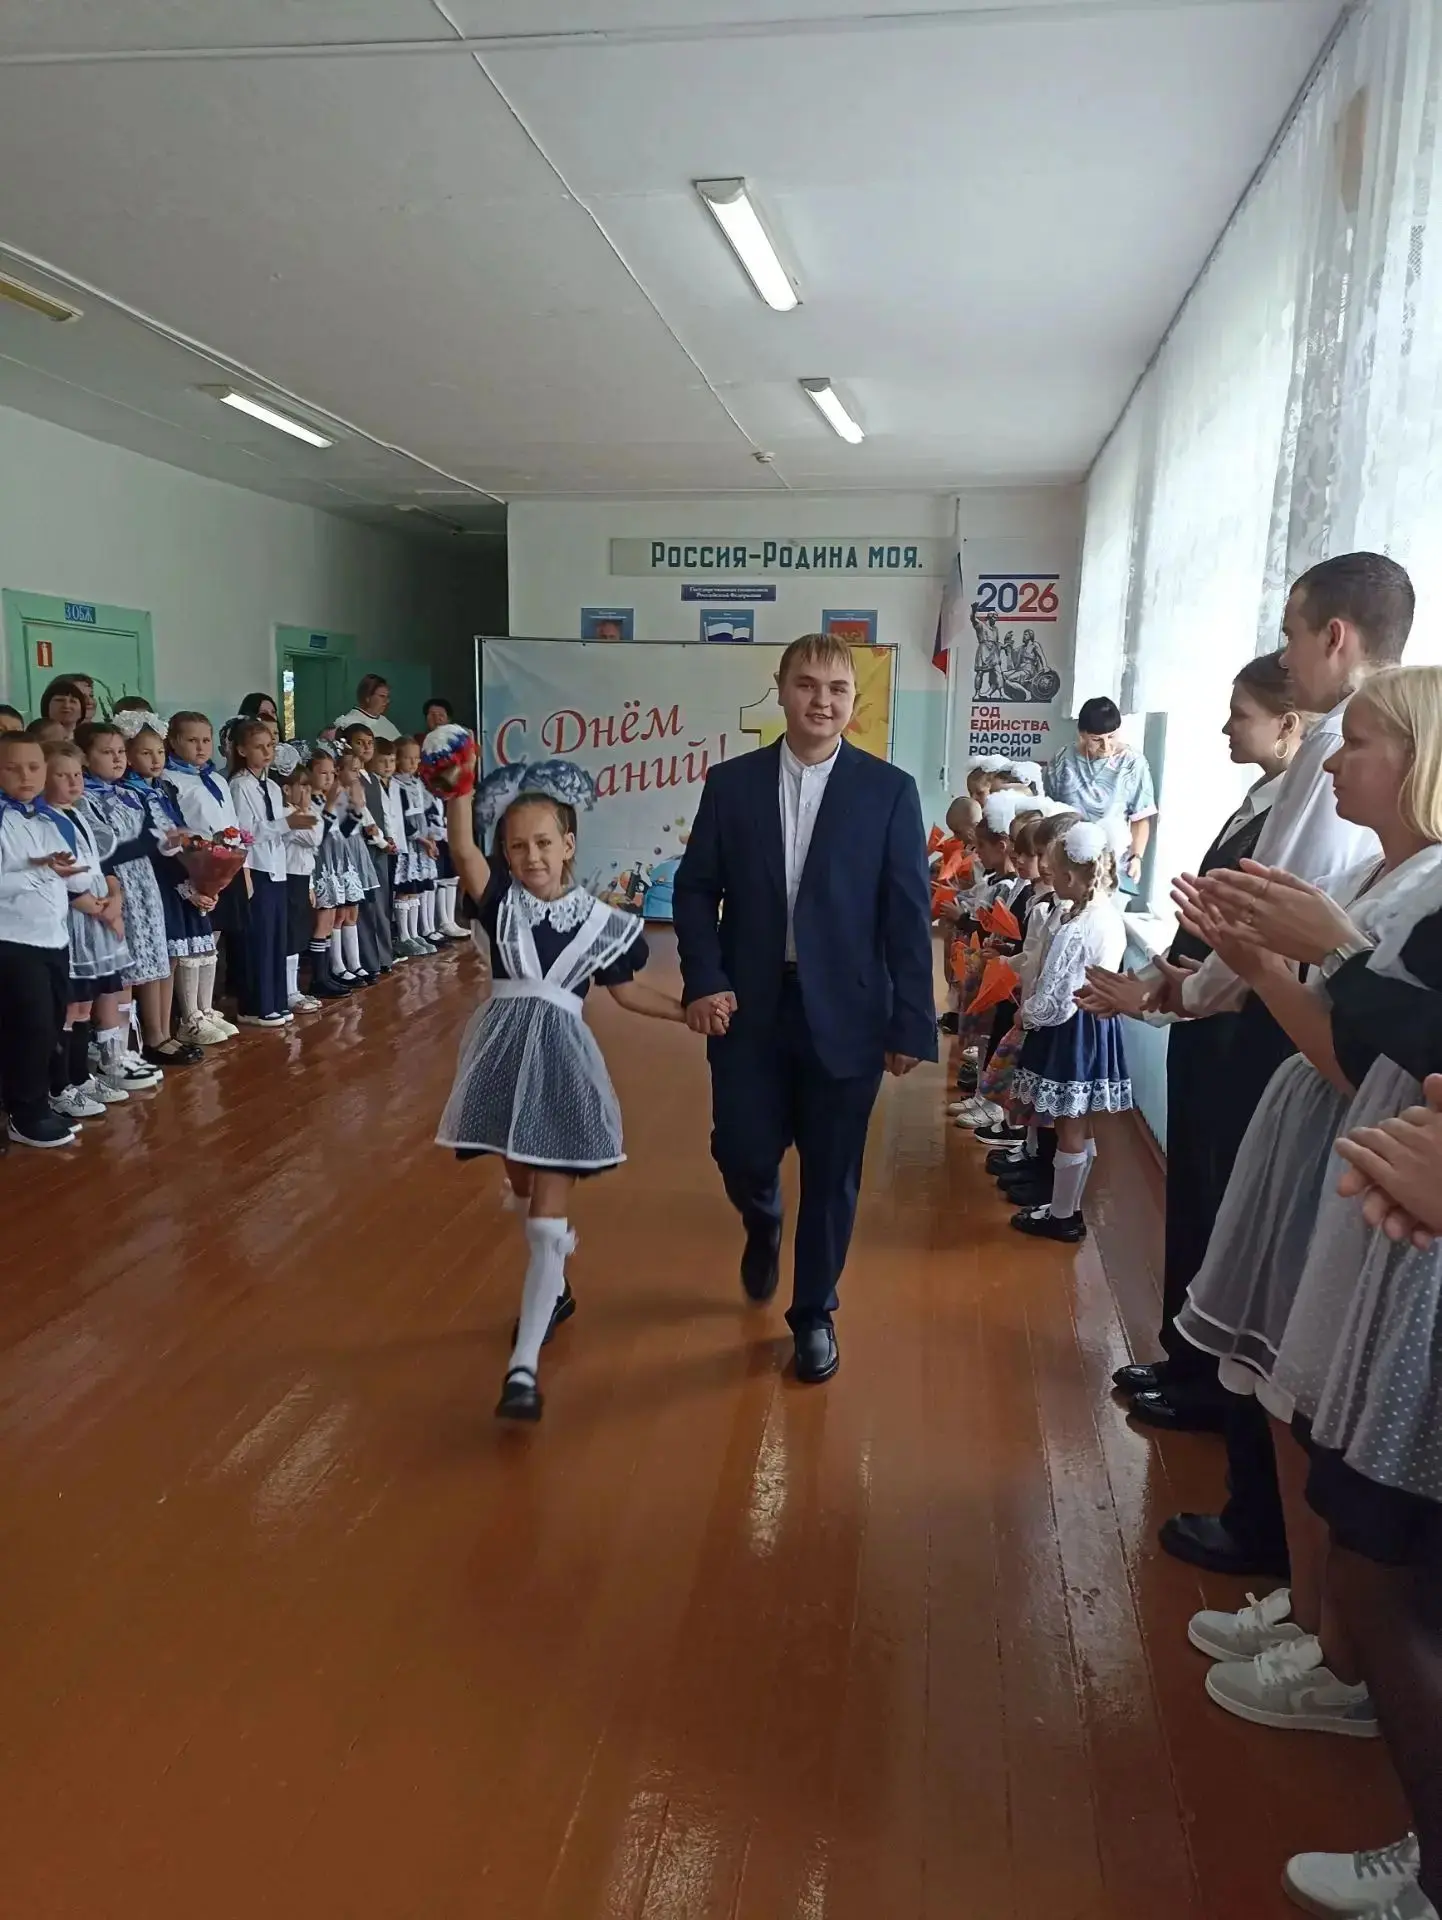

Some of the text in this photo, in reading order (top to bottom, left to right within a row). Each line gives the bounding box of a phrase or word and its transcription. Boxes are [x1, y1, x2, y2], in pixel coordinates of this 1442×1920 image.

[976, 582, 1060, 614] 2026
[971, 706, 1001, 719] ГОД
[495, 718, 527, 766] С
[541, 699, 684, 756] Днём
[970, 719, 1051, 732] ЕДИНСТВА
[969, 732, 1042, 746] НАРОДОВ
[968, 745, 1032, 757] РОССИИ
[594, 733, 727, 798] аний!
